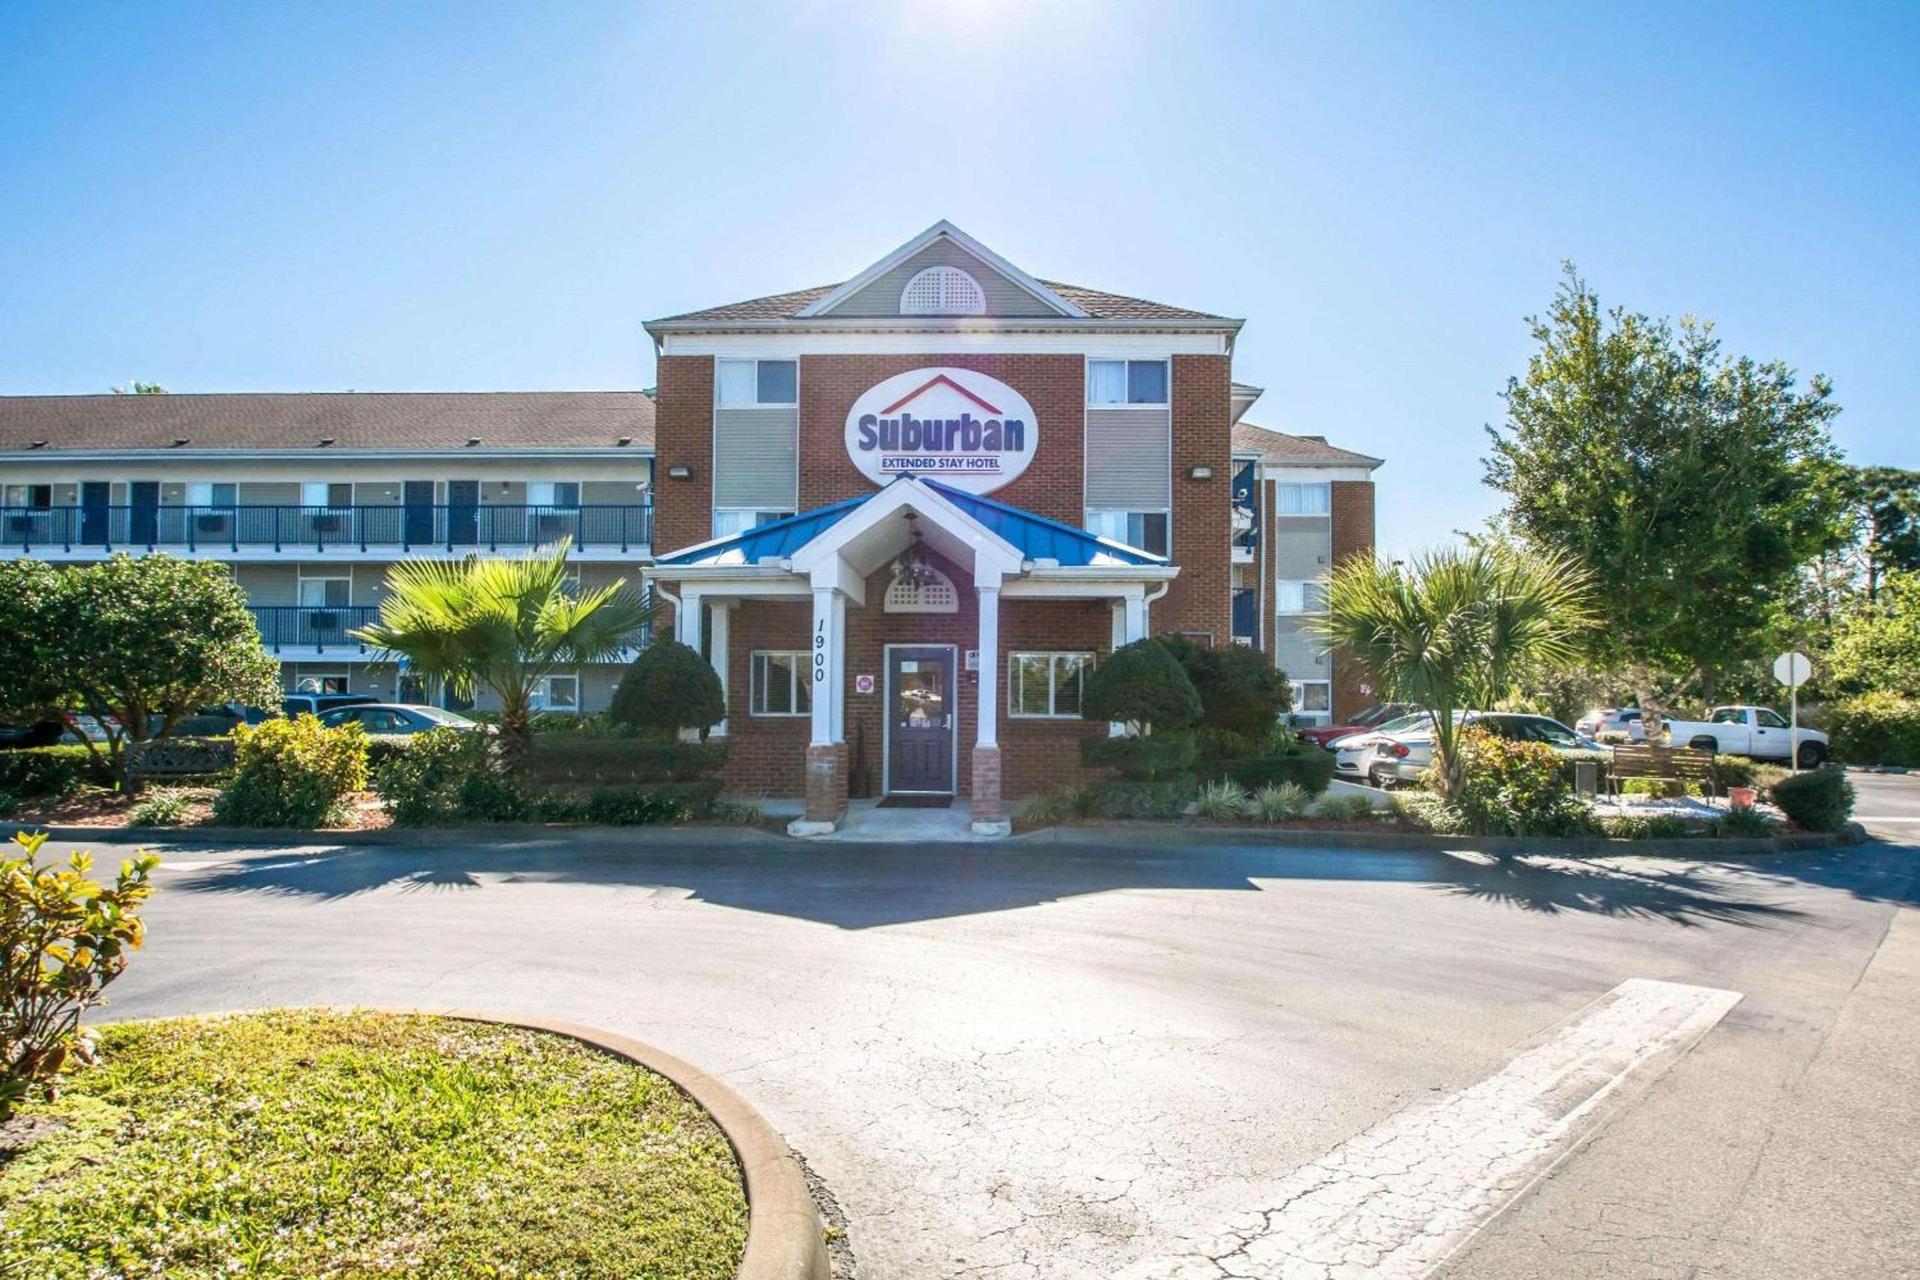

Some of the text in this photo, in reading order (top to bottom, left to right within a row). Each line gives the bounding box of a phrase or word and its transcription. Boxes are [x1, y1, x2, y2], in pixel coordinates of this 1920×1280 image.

[858, 413, 1025, 452] Suburban
[882, 457, 1000, 468] EXTENDED STAY HOTEL
[815, 618, 824, 682] 1900
